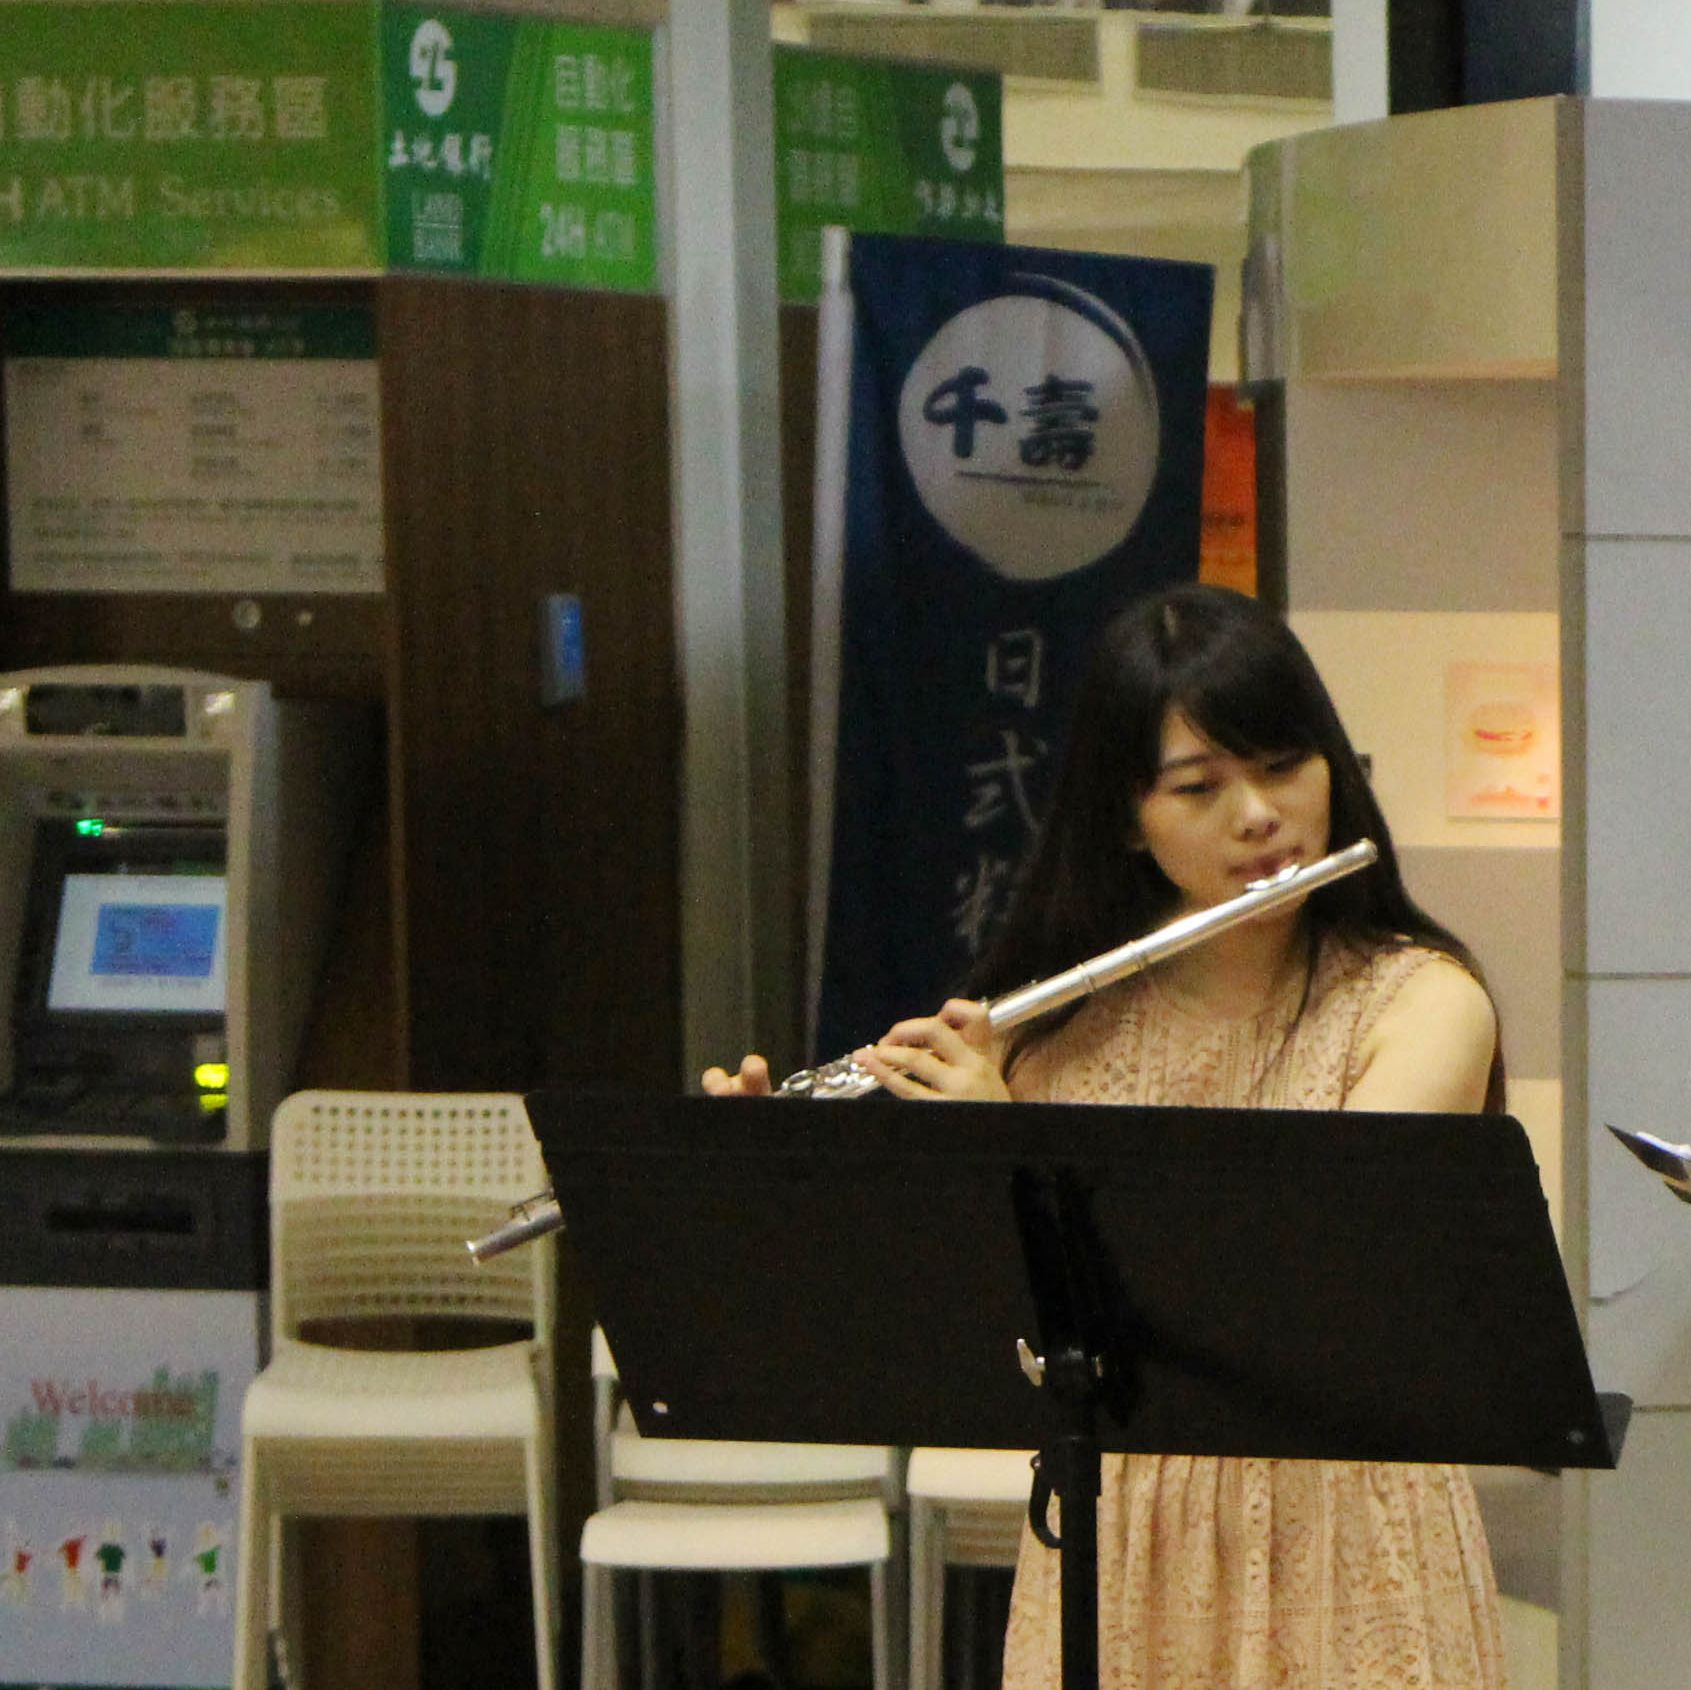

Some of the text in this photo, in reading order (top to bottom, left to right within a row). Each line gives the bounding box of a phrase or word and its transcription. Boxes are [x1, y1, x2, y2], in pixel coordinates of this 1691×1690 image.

[0, 76, 328, 139] 動化服務區
[922, 366, 1100, 470] 千壽
